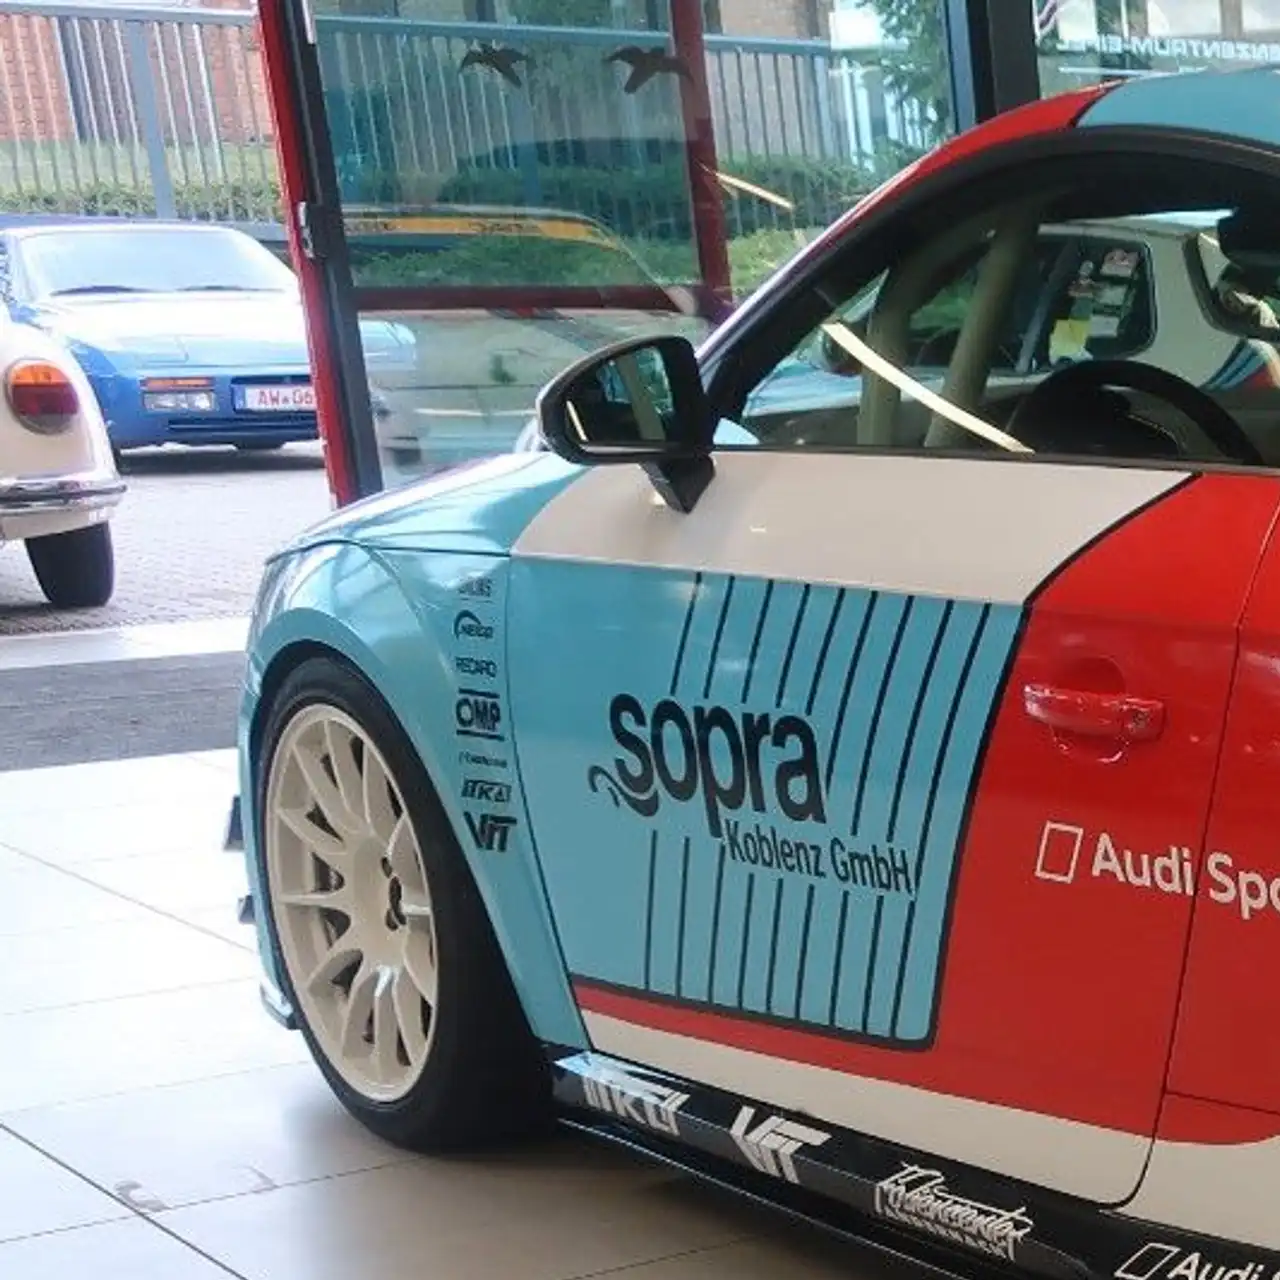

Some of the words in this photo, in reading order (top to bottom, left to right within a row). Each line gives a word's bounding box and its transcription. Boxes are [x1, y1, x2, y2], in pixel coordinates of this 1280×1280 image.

[456, 697, 501, 732] OMP
[609, 693, 827, 838] sopra
[723, 818, 826, 878] Koblenz
[829, 837, 914, 894] GmbH
[1091, 832, 1195, 896] Audi
